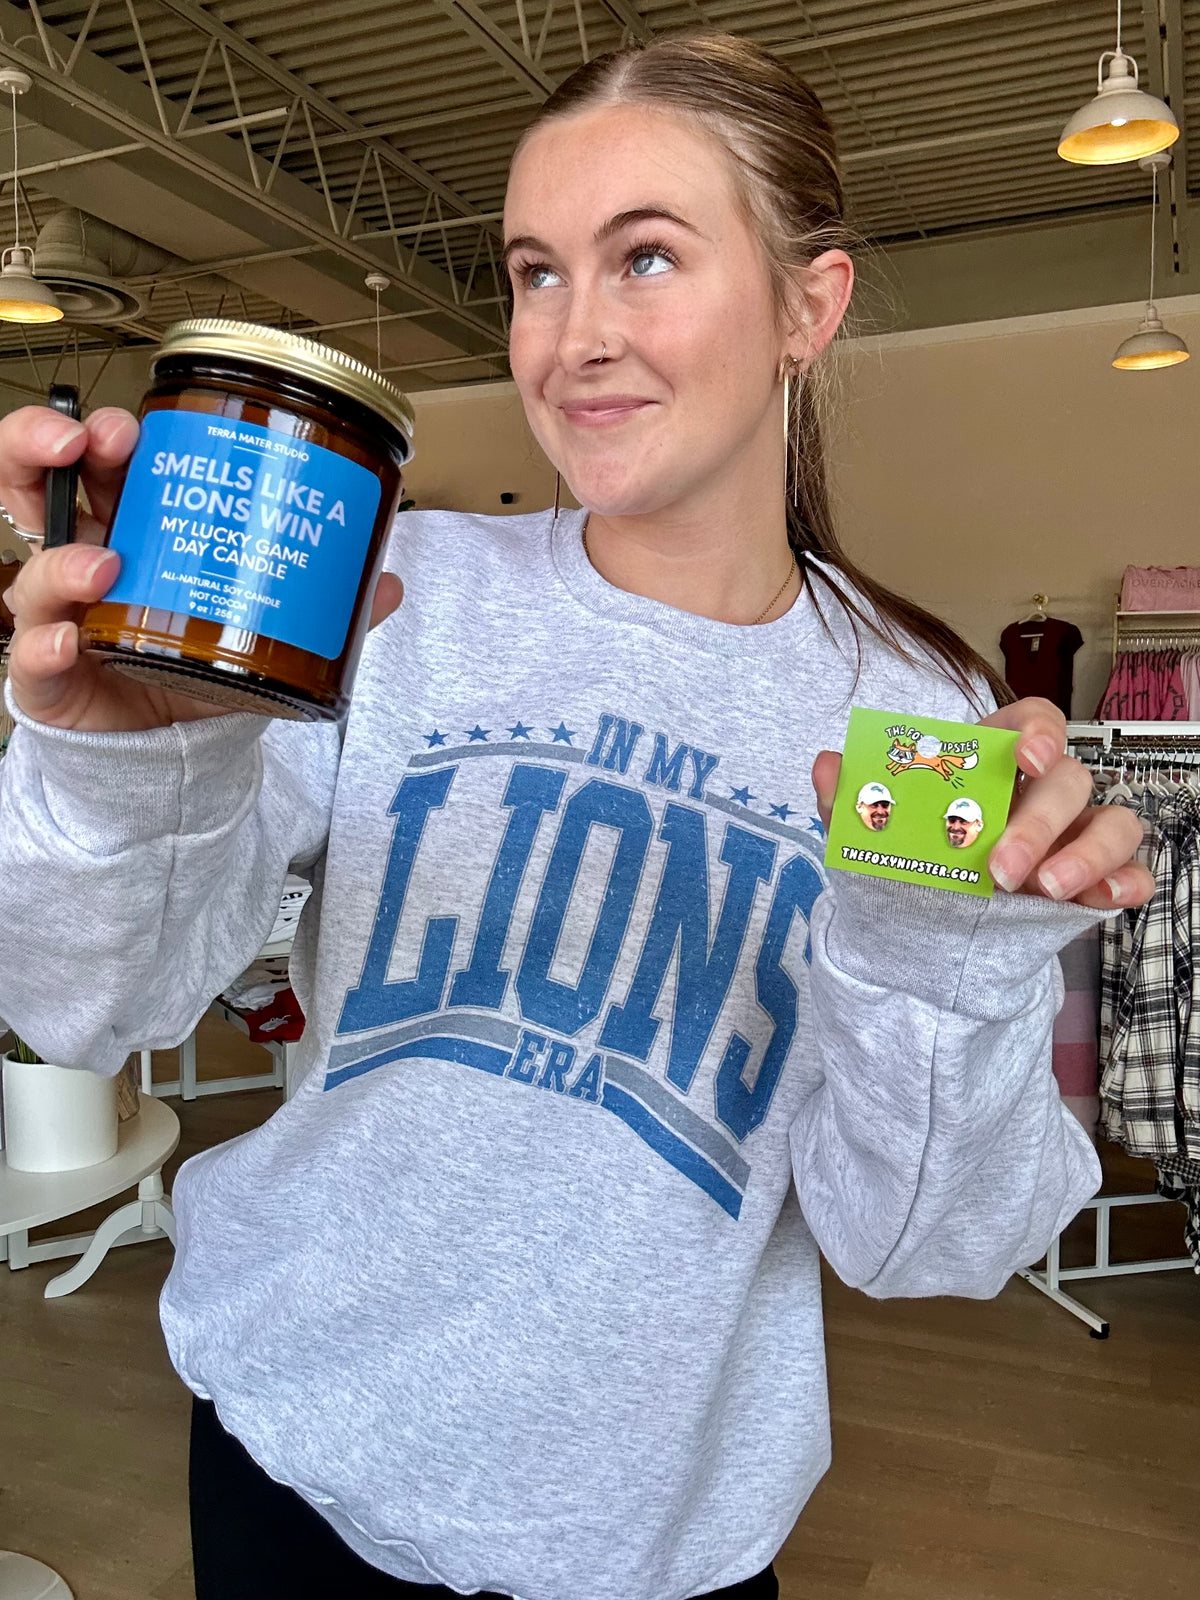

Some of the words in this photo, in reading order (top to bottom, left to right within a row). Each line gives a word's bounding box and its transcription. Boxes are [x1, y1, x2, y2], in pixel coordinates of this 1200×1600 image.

[208, 426, 237, 440] TERRA
[239, 433, 272, 450] MATER
[273, 443, 309, 462] STUDIO
[151, 451, 254, 491] SMELLS
[261, 473, 324, 515] LIKE
[326, 500, 346, 527] A
[161, 482, 251, 522] LIONS
[261, 503, 323, 547] WIN
[161, 516, 189, 534] MY
[190, 521, 253, 548] LUCKY
[255, 539, 310, 569] GAME
[173, 536, 211, 557] DAY
[213, 546, 288, 580] CANDLE
[161, 570, 222, 591] ALL-NATURAL
[223, 584, 243, 597] SOY
[243, 590, 281, 609] CANDLE
[189, 589, 210, 601] HOT
[211, 594, 248, 612] COCOA
[189, 601, 197, 610] 9
[885, 725, 906, 738] THE
[585, 713, 644, 775] IN
[642, 731, 720, 801] MY
[841, 846, 980, 884] THEFOXYHIPSTER.COM
[334, 763, 828, 1143] LIONS
[505, 1029, 606, 1104] ERA
